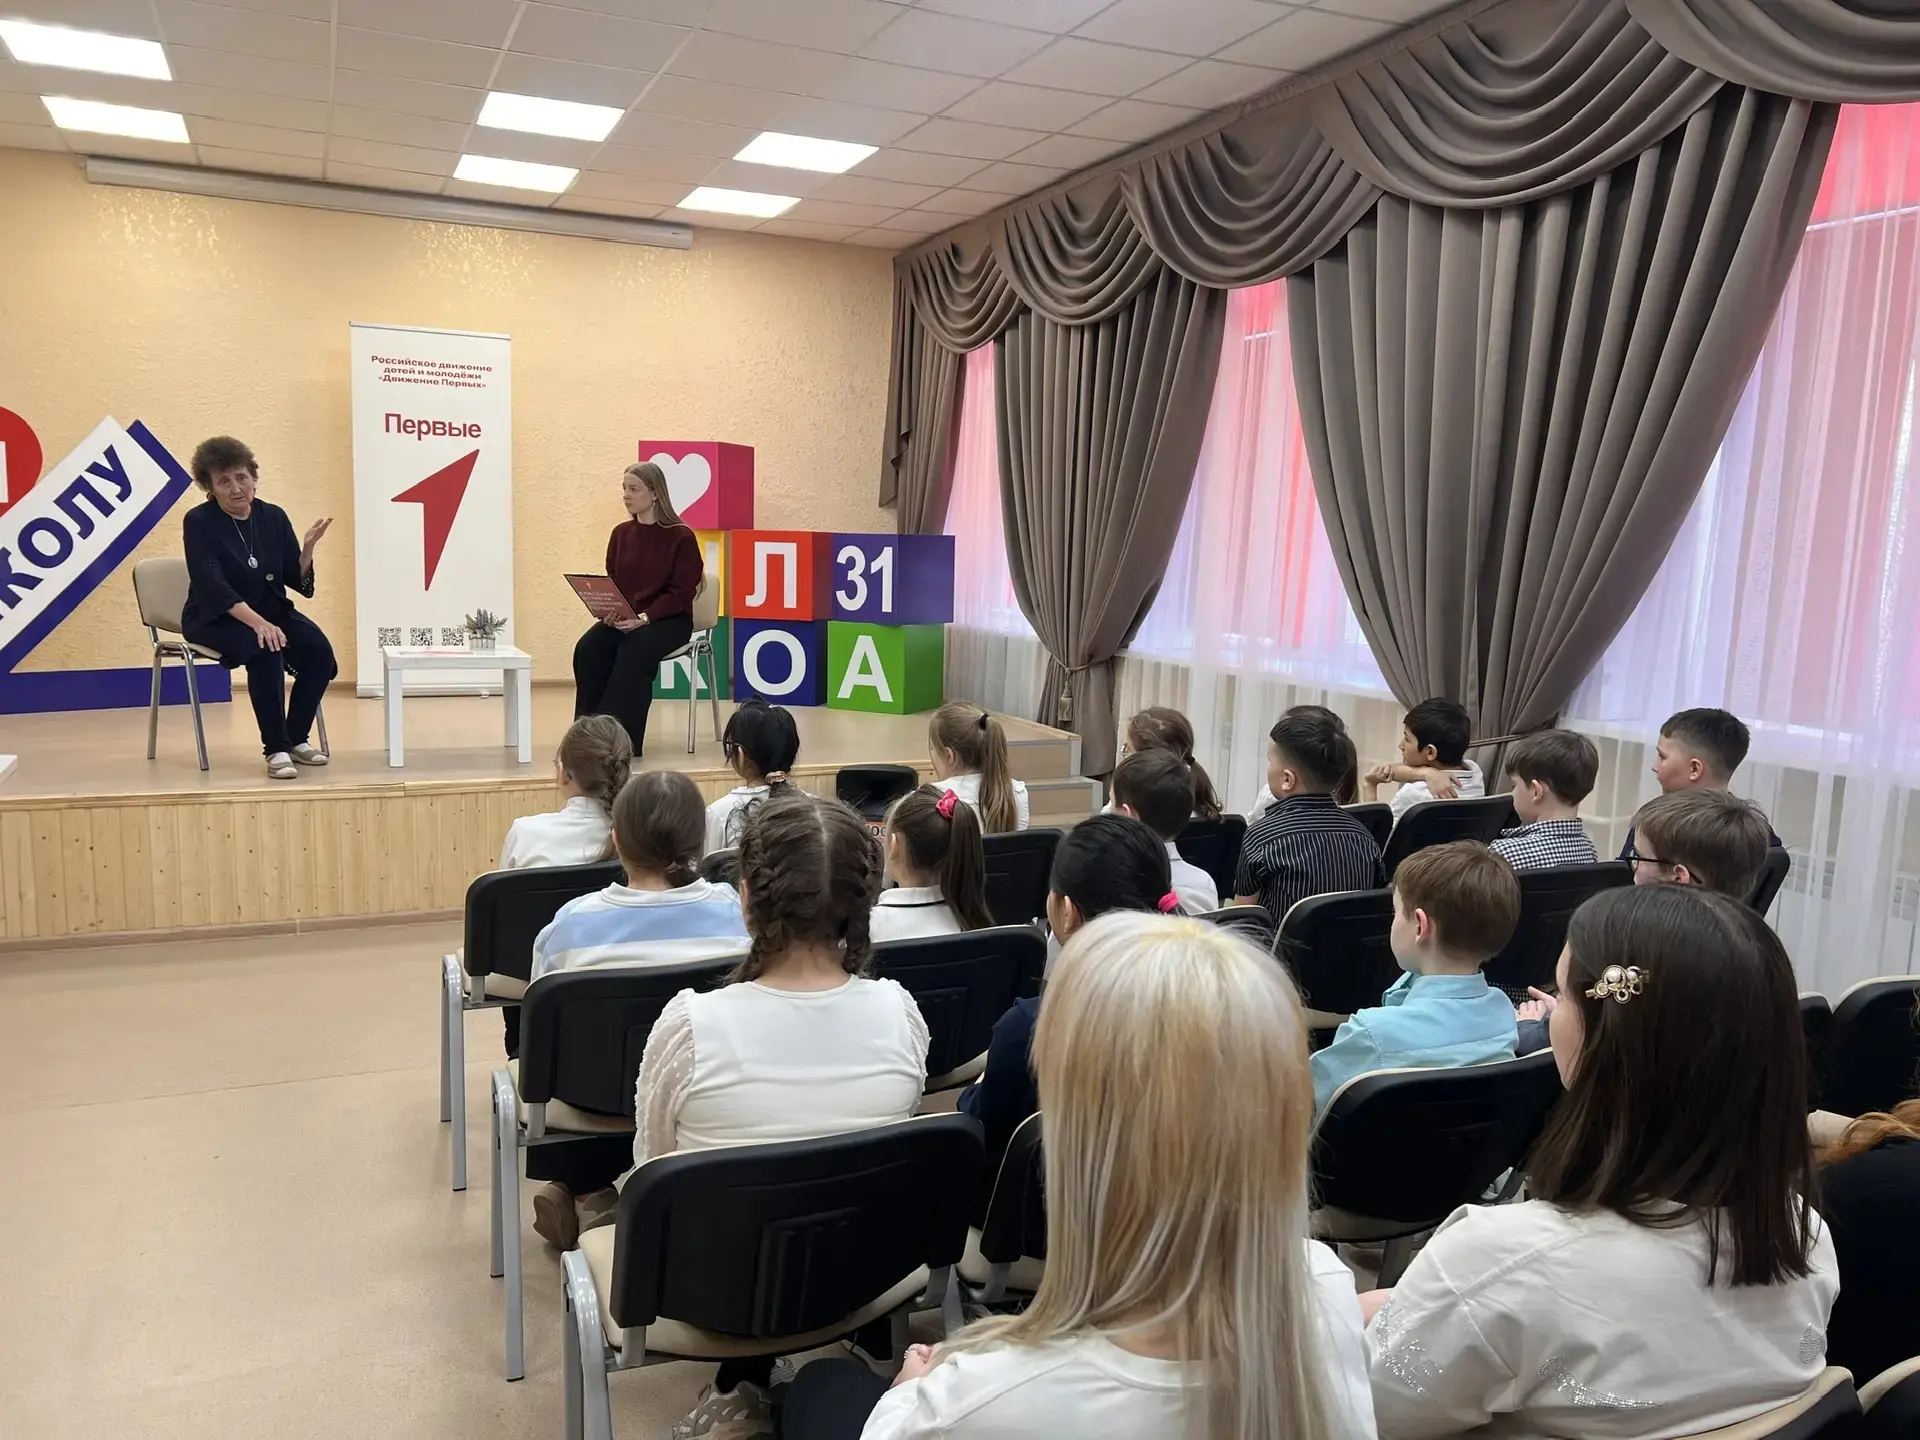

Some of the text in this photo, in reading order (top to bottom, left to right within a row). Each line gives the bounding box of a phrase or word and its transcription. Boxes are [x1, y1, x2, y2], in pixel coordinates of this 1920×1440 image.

[371, 355, 493, 373] Российское движение
[383, 366, 416, 375] детей
[426, 369, 482, 380] молодёжи
[378, 374, 487, 389] «Движение Первых»
[384, 412, 482, 441] Первые
[0, 444, 132, 620] КОЛУ
[745, 541, 797, 608] Л
[835, 545, 894, 613] 31
[742, 629, 807, 696] О
[836, 634, 894, 703] А
